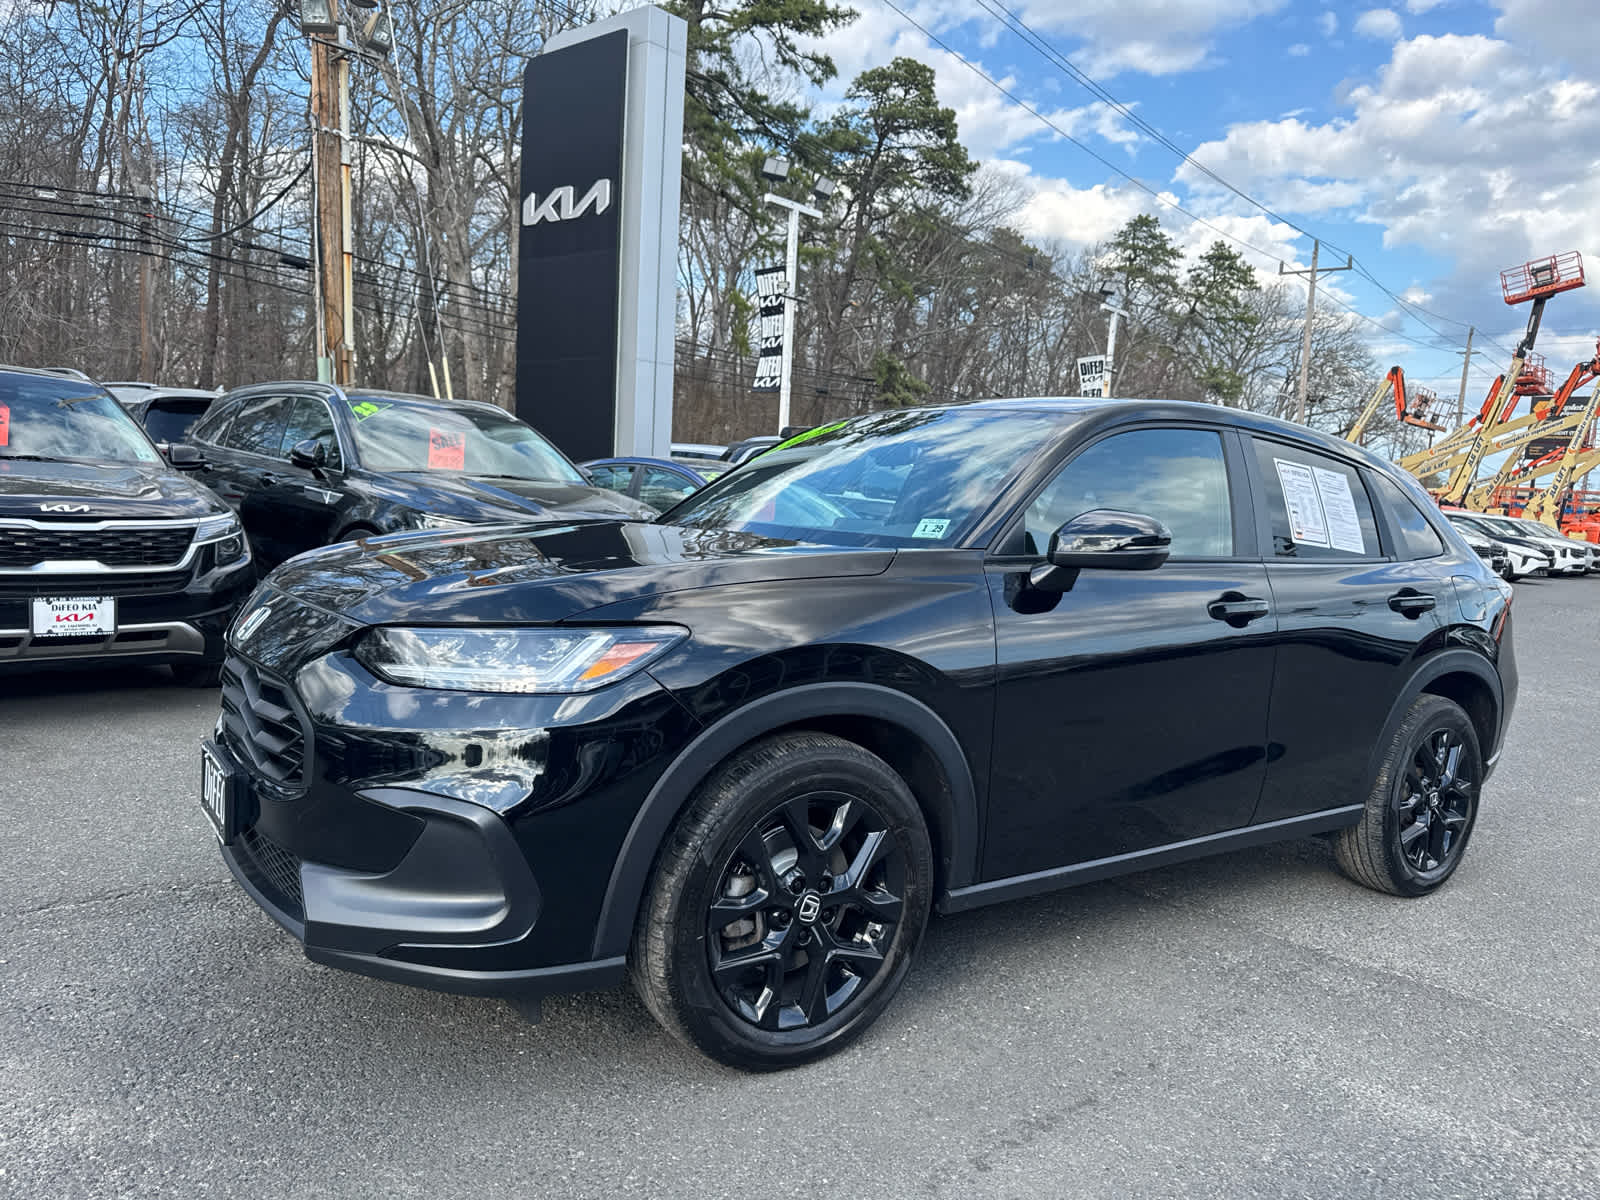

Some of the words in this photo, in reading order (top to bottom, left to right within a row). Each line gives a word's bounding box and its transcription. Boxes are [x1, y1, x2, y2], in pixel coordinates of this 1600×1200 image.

[522, 178, 610, 226] KIA
[40, 503, 90, 512] KIA
[51, 603, 79, 612] DiFEO
[81, 603, 97, 611] KIA
[55, 612, 94, 622] KIA
